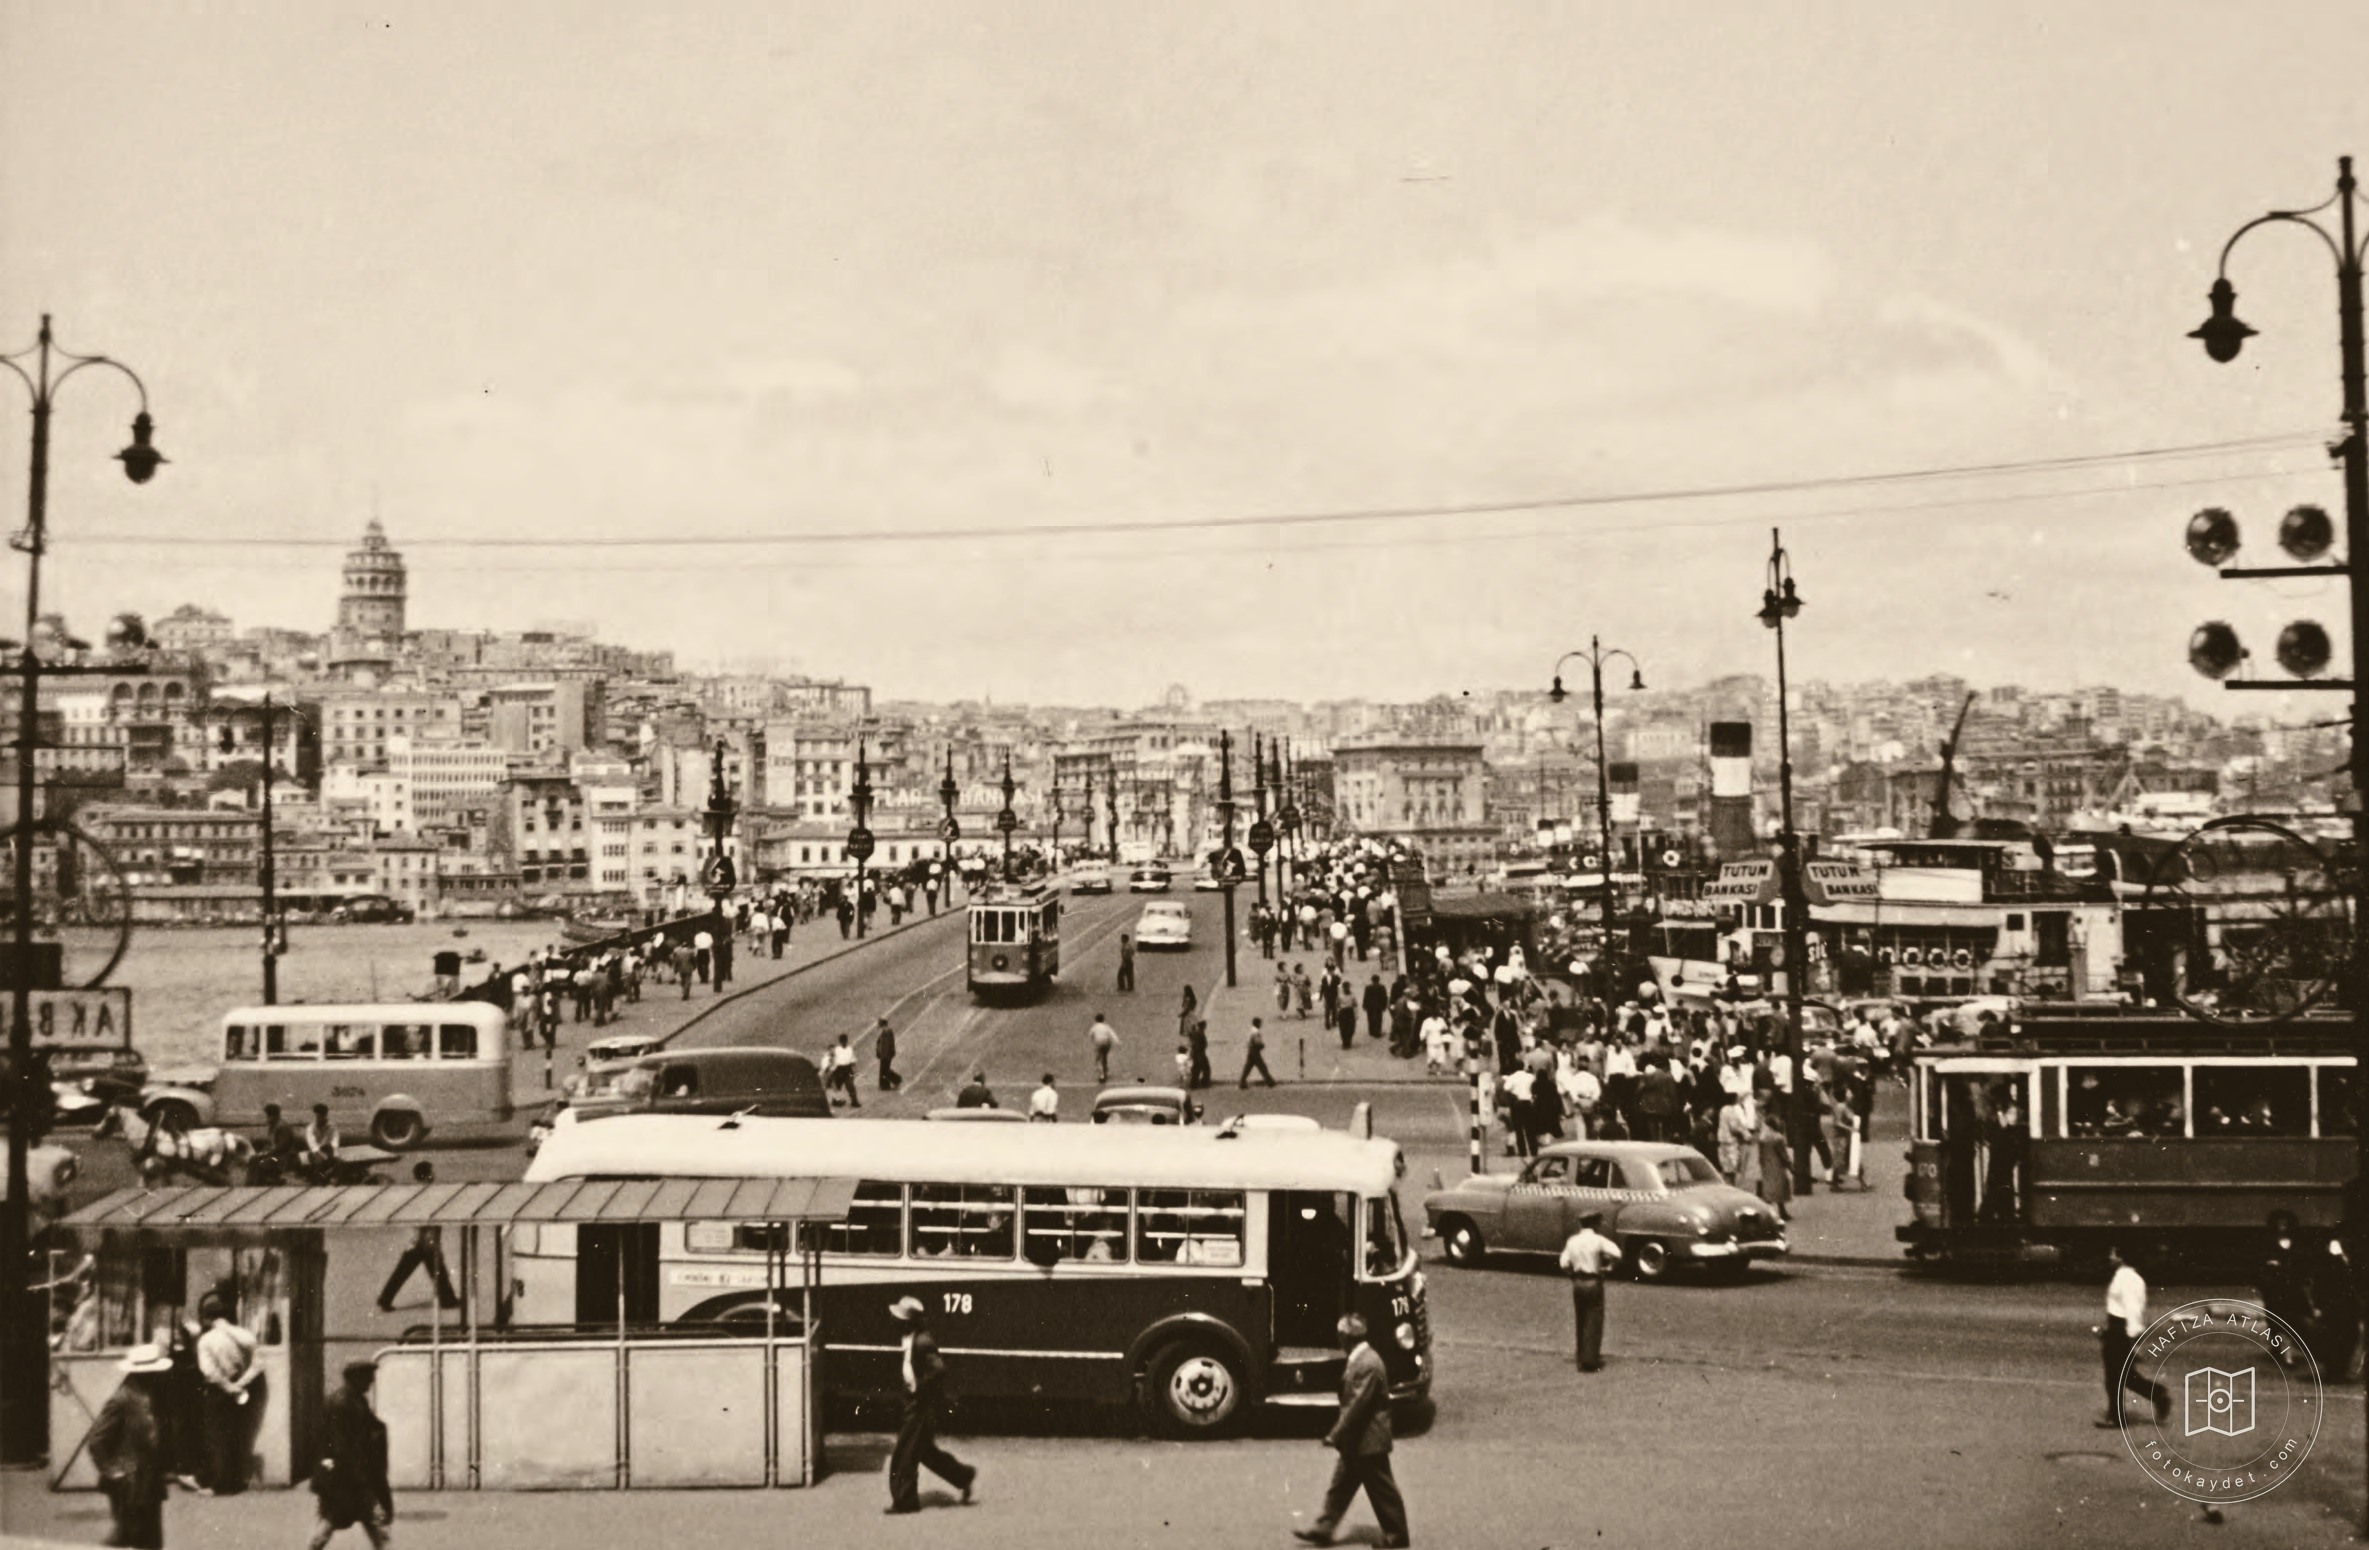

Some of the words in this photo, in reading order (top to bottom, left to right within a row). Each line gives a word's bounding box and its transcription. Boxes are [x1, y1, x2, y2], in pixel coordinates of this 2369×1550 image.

[959, 787, 1043, 807] BANASI
[1722, 863, 1769, 878] TUTUM
[1810, 865, 1860, 878] TUTUM
[1704, 883, 1759, 897] BANKASI
[1826, 884, 1879, 897] BANKASI
[943, 1292, 973, 1315] 178
